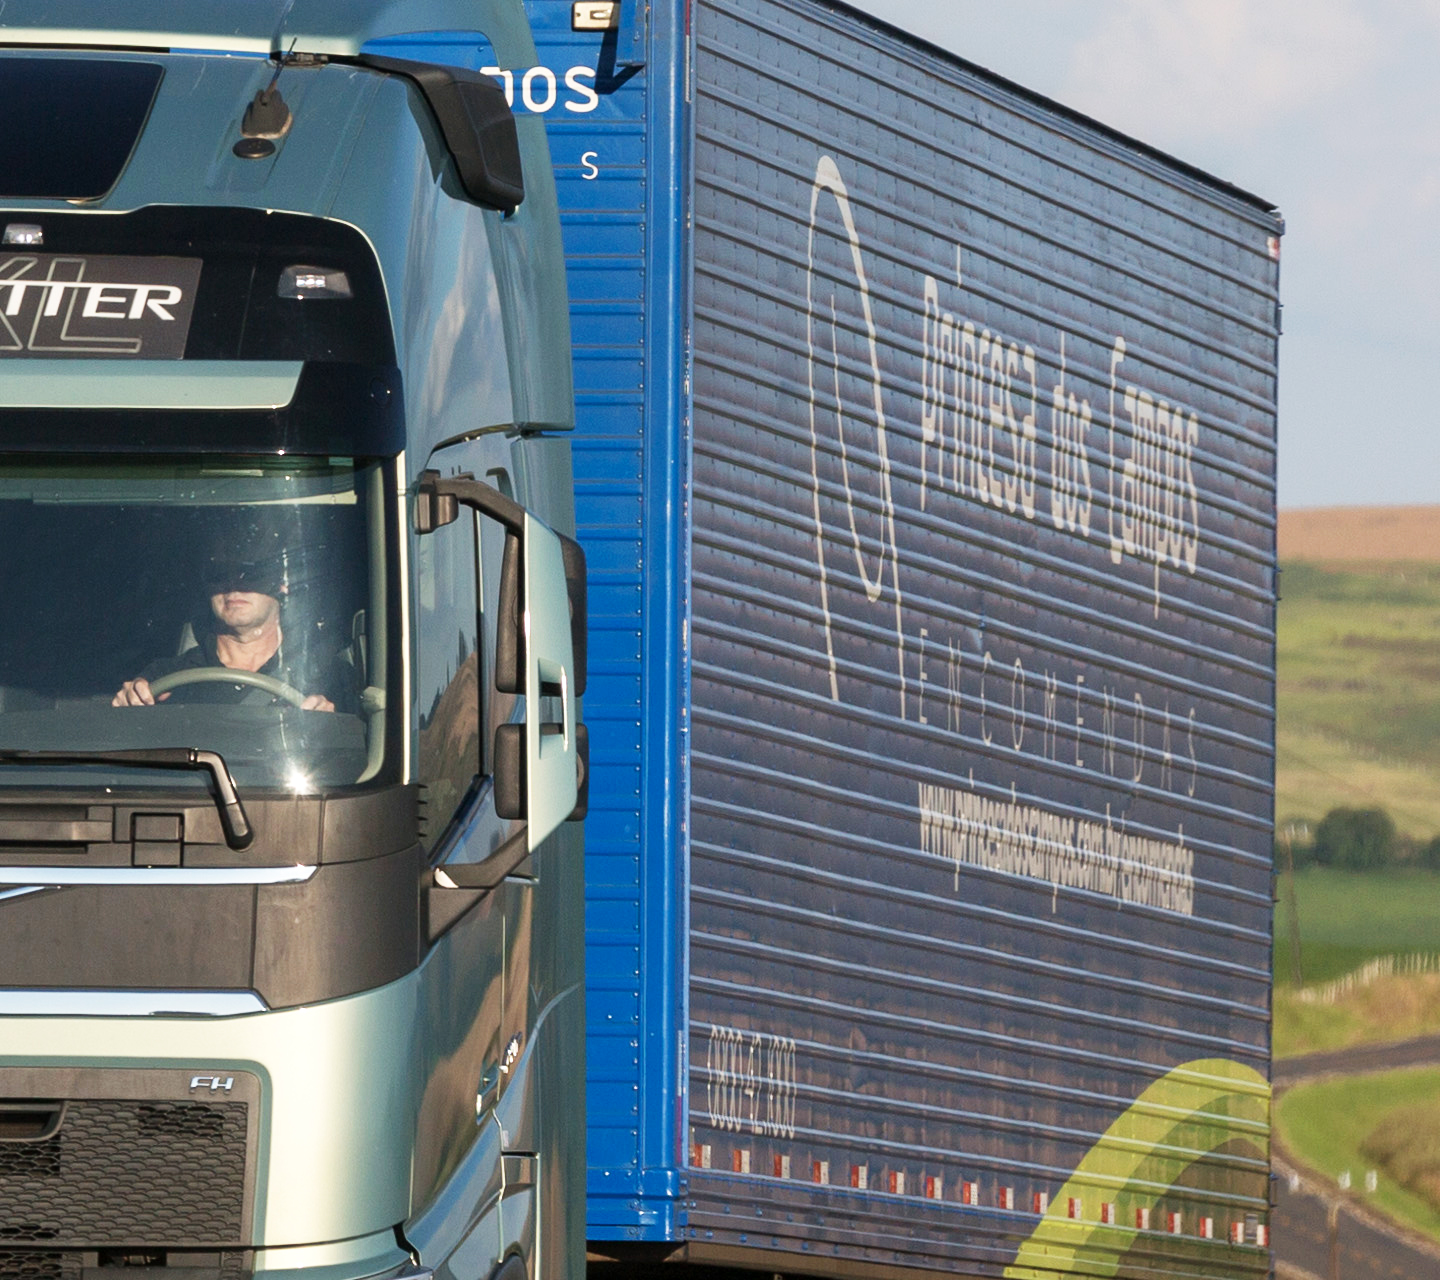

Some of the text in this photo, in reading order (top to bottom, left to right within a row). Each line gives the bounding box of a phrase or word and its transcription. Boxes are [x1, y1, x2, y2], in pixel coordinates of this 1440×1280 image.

[921, 243, 1199, 620] Princesa dos Campos
[190, 1076, 234, 1091] FH
